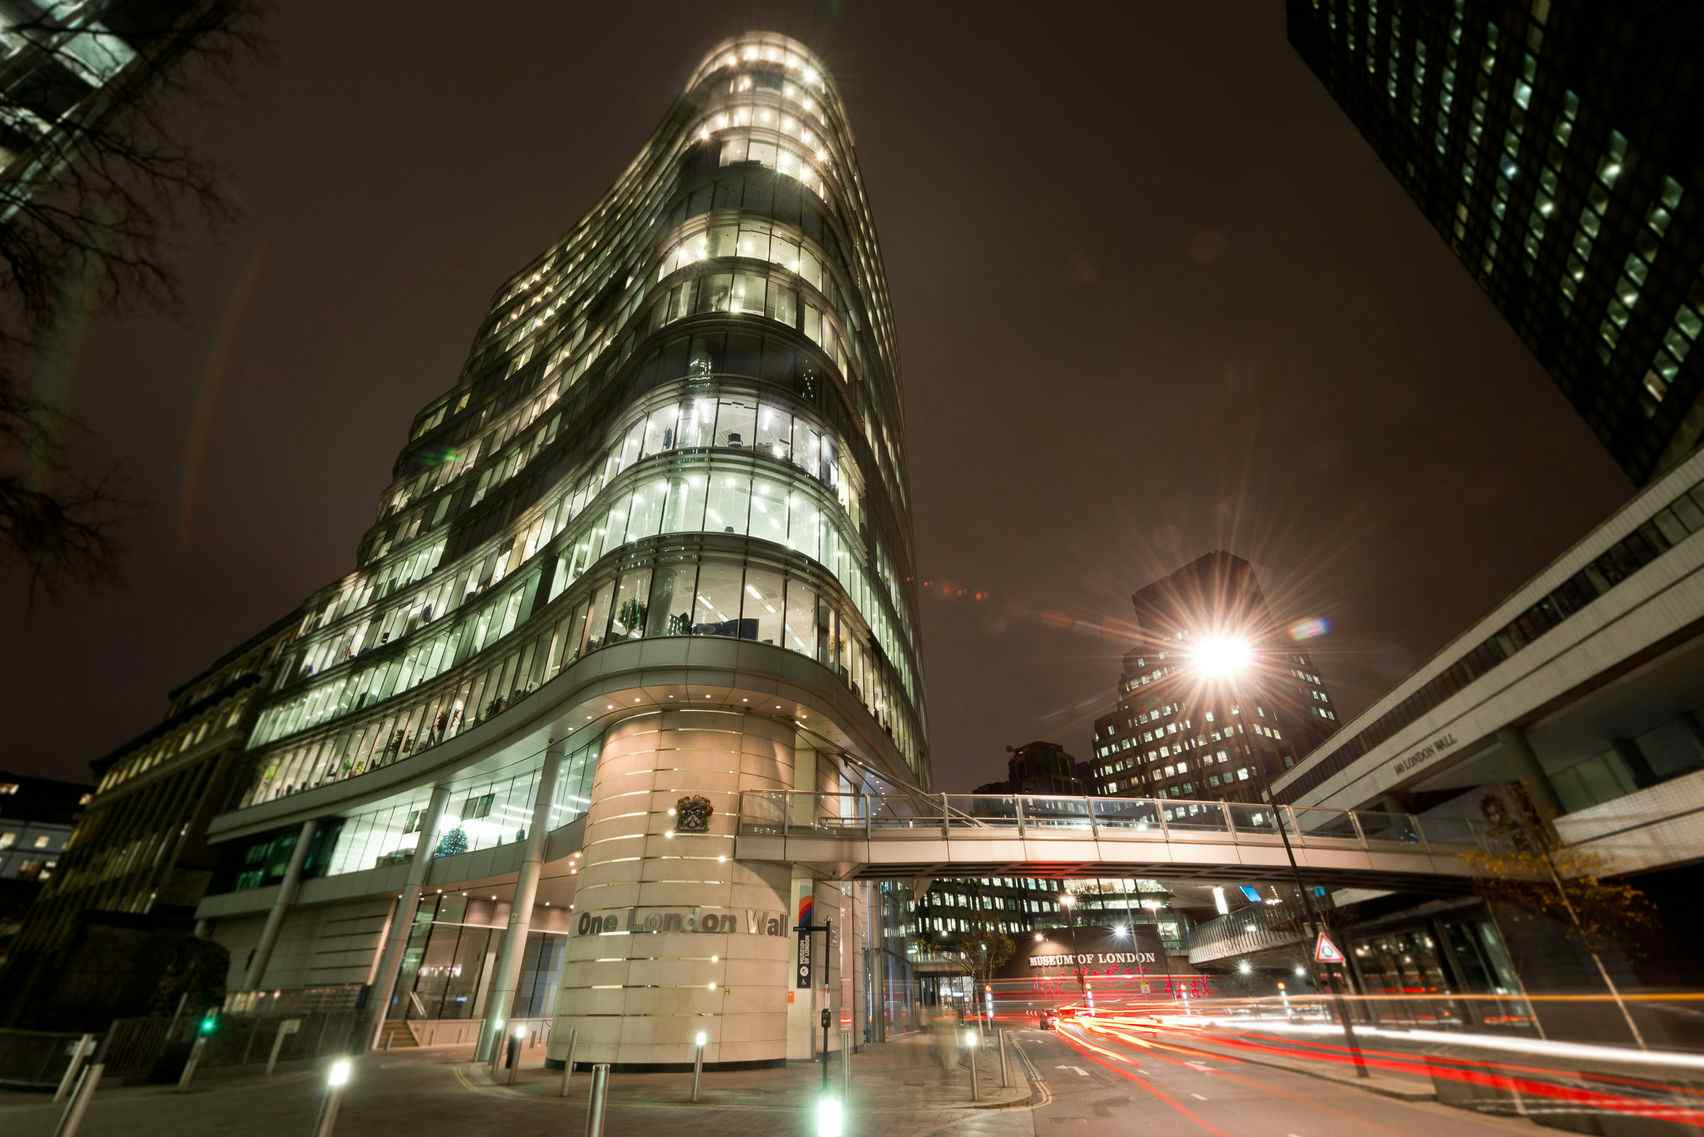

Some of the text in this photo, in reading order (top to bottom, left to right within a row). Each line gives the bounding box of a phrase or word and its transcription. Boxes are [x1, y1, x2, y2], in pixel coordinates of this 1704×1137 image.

[1402, 746, 1434, 769] LONDON
[578, 907, 788, 938] One London Wall
[1029, 952, 1155, 966] MUSEUM OF LONDON
